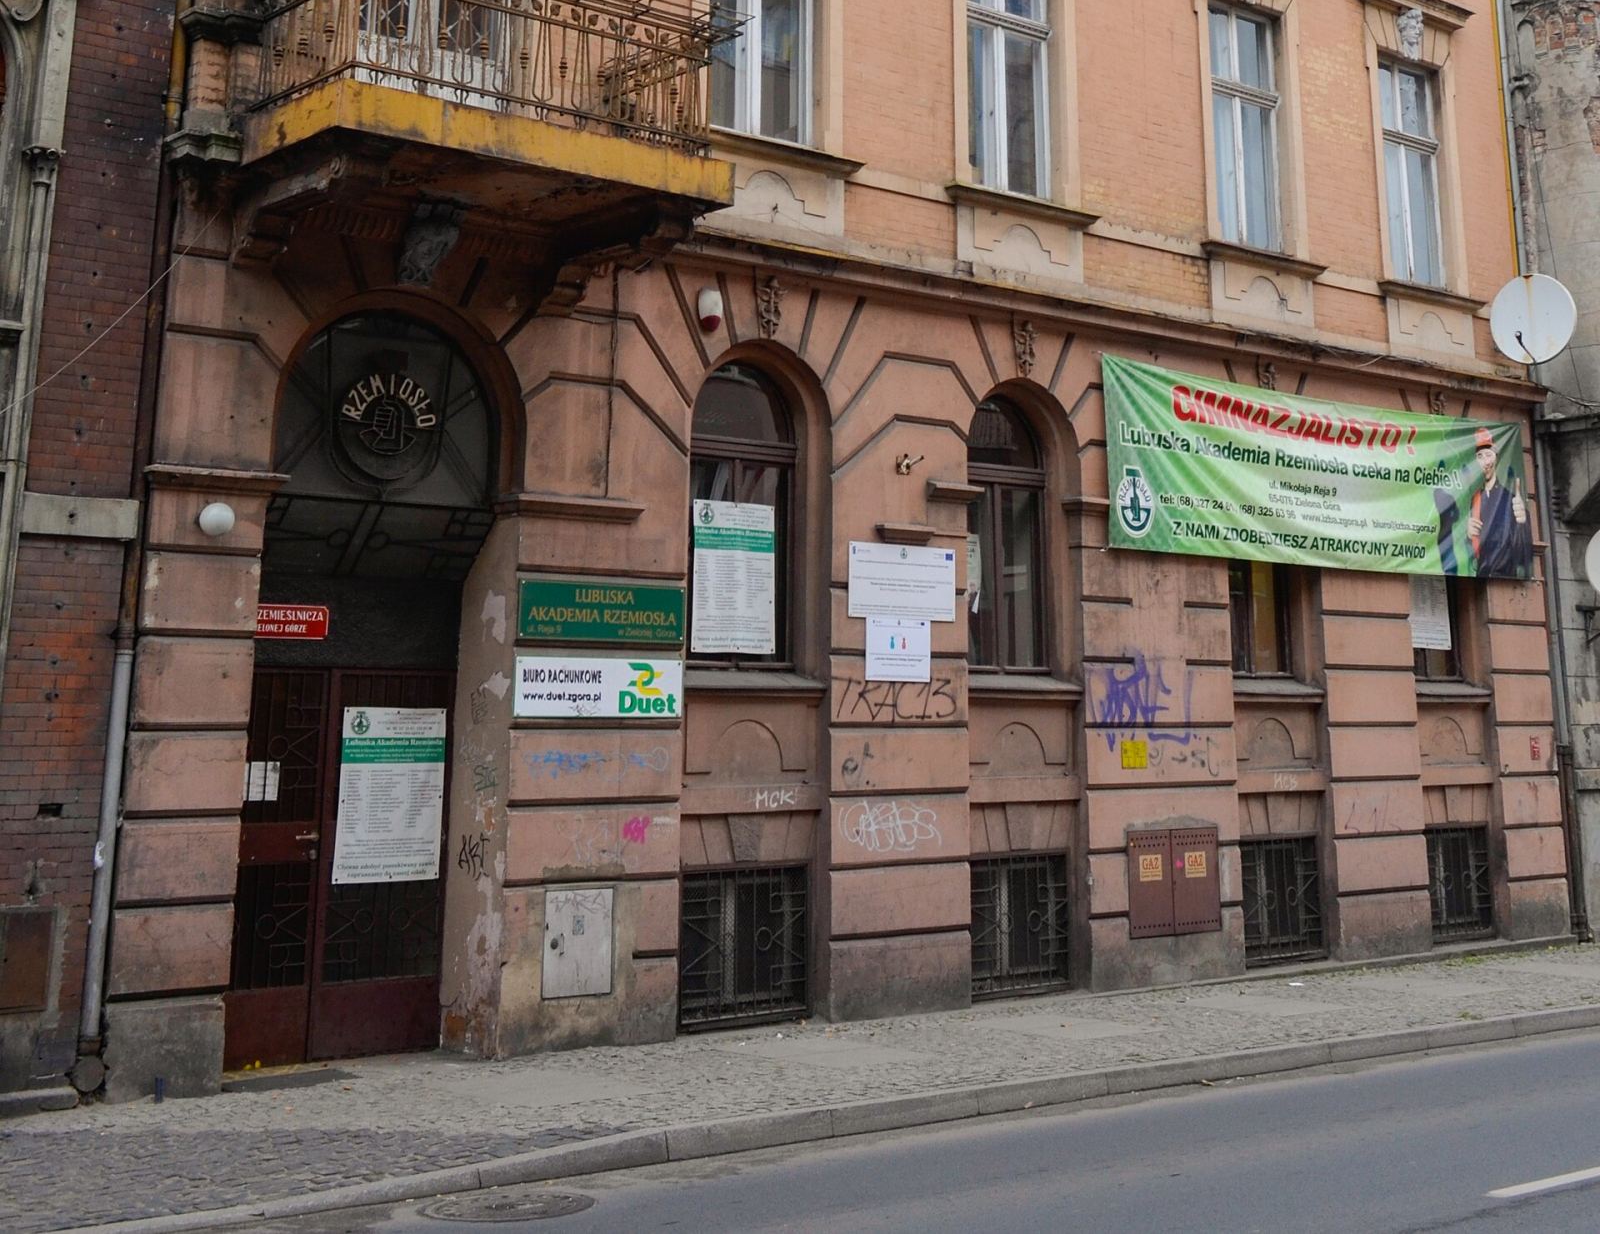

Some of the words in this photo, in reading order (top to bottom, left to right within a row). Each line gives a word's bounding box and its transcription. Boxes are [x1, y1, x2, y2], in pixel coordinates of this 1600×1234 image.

[342, 373, 436, 428] RZEMIOSŁO
[1171, 384, 1402, 454] GIMNAZJALISTO
[1119, 421, 1191, 454] Lubuska
[1195, 435, 1270, 466] Akademia
[1275, 447, 1348, 476] Rzemiosła
[1352, 462, 1391, 481] czeka
[1394, 469, 1410, 483] na
[1413, 466, 1452, 487] Ciebie
[1279, 481, 1313, 495] Mikołaja
[1313, 485, 1331, 499] Reja
[1331, 487, 1337, 496] 9
[1177, 496, 1194, 508] (68)
[1212, 500, 1224, 511] 24
[1239, 504, 1256, 517] (68)
[1257, 506, 1274, 517] 325
[1275, 508, 1285, 519] 63
[1294, 497, 1322, 509] Zielona
[1173, 521, 1182, 536] Z
[1185, 523, 1221, 540] NAMI
[1223, 527, 1308, 550] ZDOBĘDZIESZ
[1310, 536, 1390, 558] ATRAKCYJNY
[1391, 542, 1427, 559] ZAWÓD
[575, 588, 635, 605] LUBUSKA
[257, 609, 324, 622] ZEMIEŚLNICZA
[528, 606, 600, 623] AKADEMIA
[603, 609, 677, 626] RZEMIOSŁA
[257, 623, 282, 633] ELONEJ
[523, 669, 546, 683] BIURO
[548, 669, 602, 684] RACHUNKOWE
[523, 692, 602, 703] www.duet.zgora.pl
[619, 690, 676, 714] Duet
[1142, 857, 1159, 871] GAZ
[1187, 854, 1204, 867] GAZ
